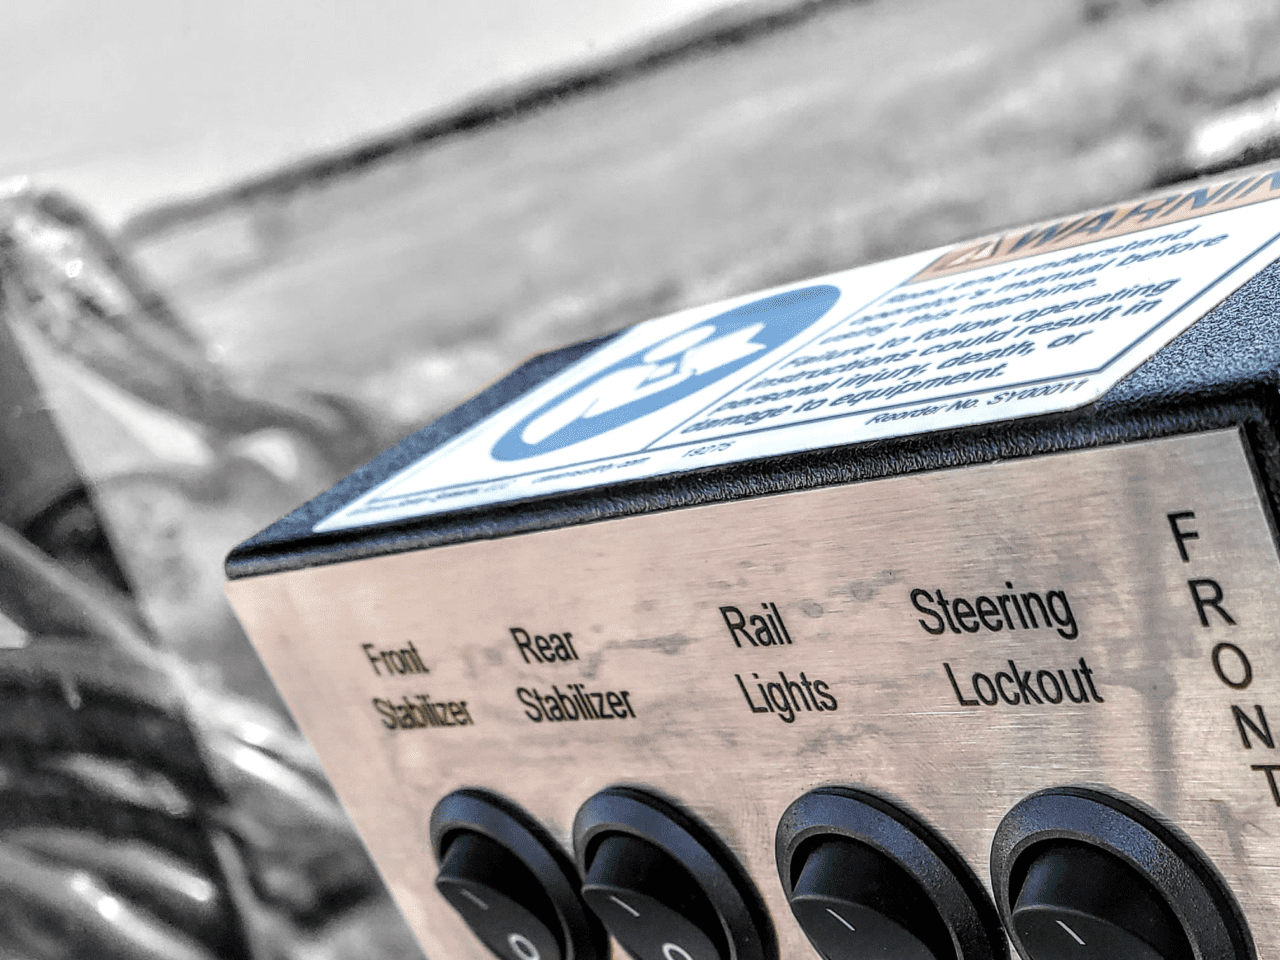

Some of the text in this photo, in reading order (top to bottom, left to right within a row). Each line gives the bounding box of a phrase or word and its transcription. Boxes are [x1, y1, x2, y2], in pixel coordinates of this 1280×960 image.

[995, 258, 1117, 294] manual
[1115, 234, 1229, 267] before
[1014, 225, 1201, 276] understand
[779, 278, 1181, 370] Failure to follow operating
[900, 309, 957, 328] this
[960, 278, 1097, 314] machine.
[746, 299, 1162, 391] instructions could result in
[708, 330, 1094, 415] personal injury, death, or
[680, 363, 1008, 434] damage to equipment.
[865, 378, 1089, 425] Reorder No. SY00011
[719, 602, 793, 648] Rail
[909, 581, 1079, 640] Steering
[360, 641, 430, 676] Front
[509, 627, 580, 665] Rear
[516, 684, 637, 723] Stabilizer
[734, 671, 838, 724] Lights
[942, 657, 1105, 707] Lockout
[372, 694, 475, 731] Stabilizer
